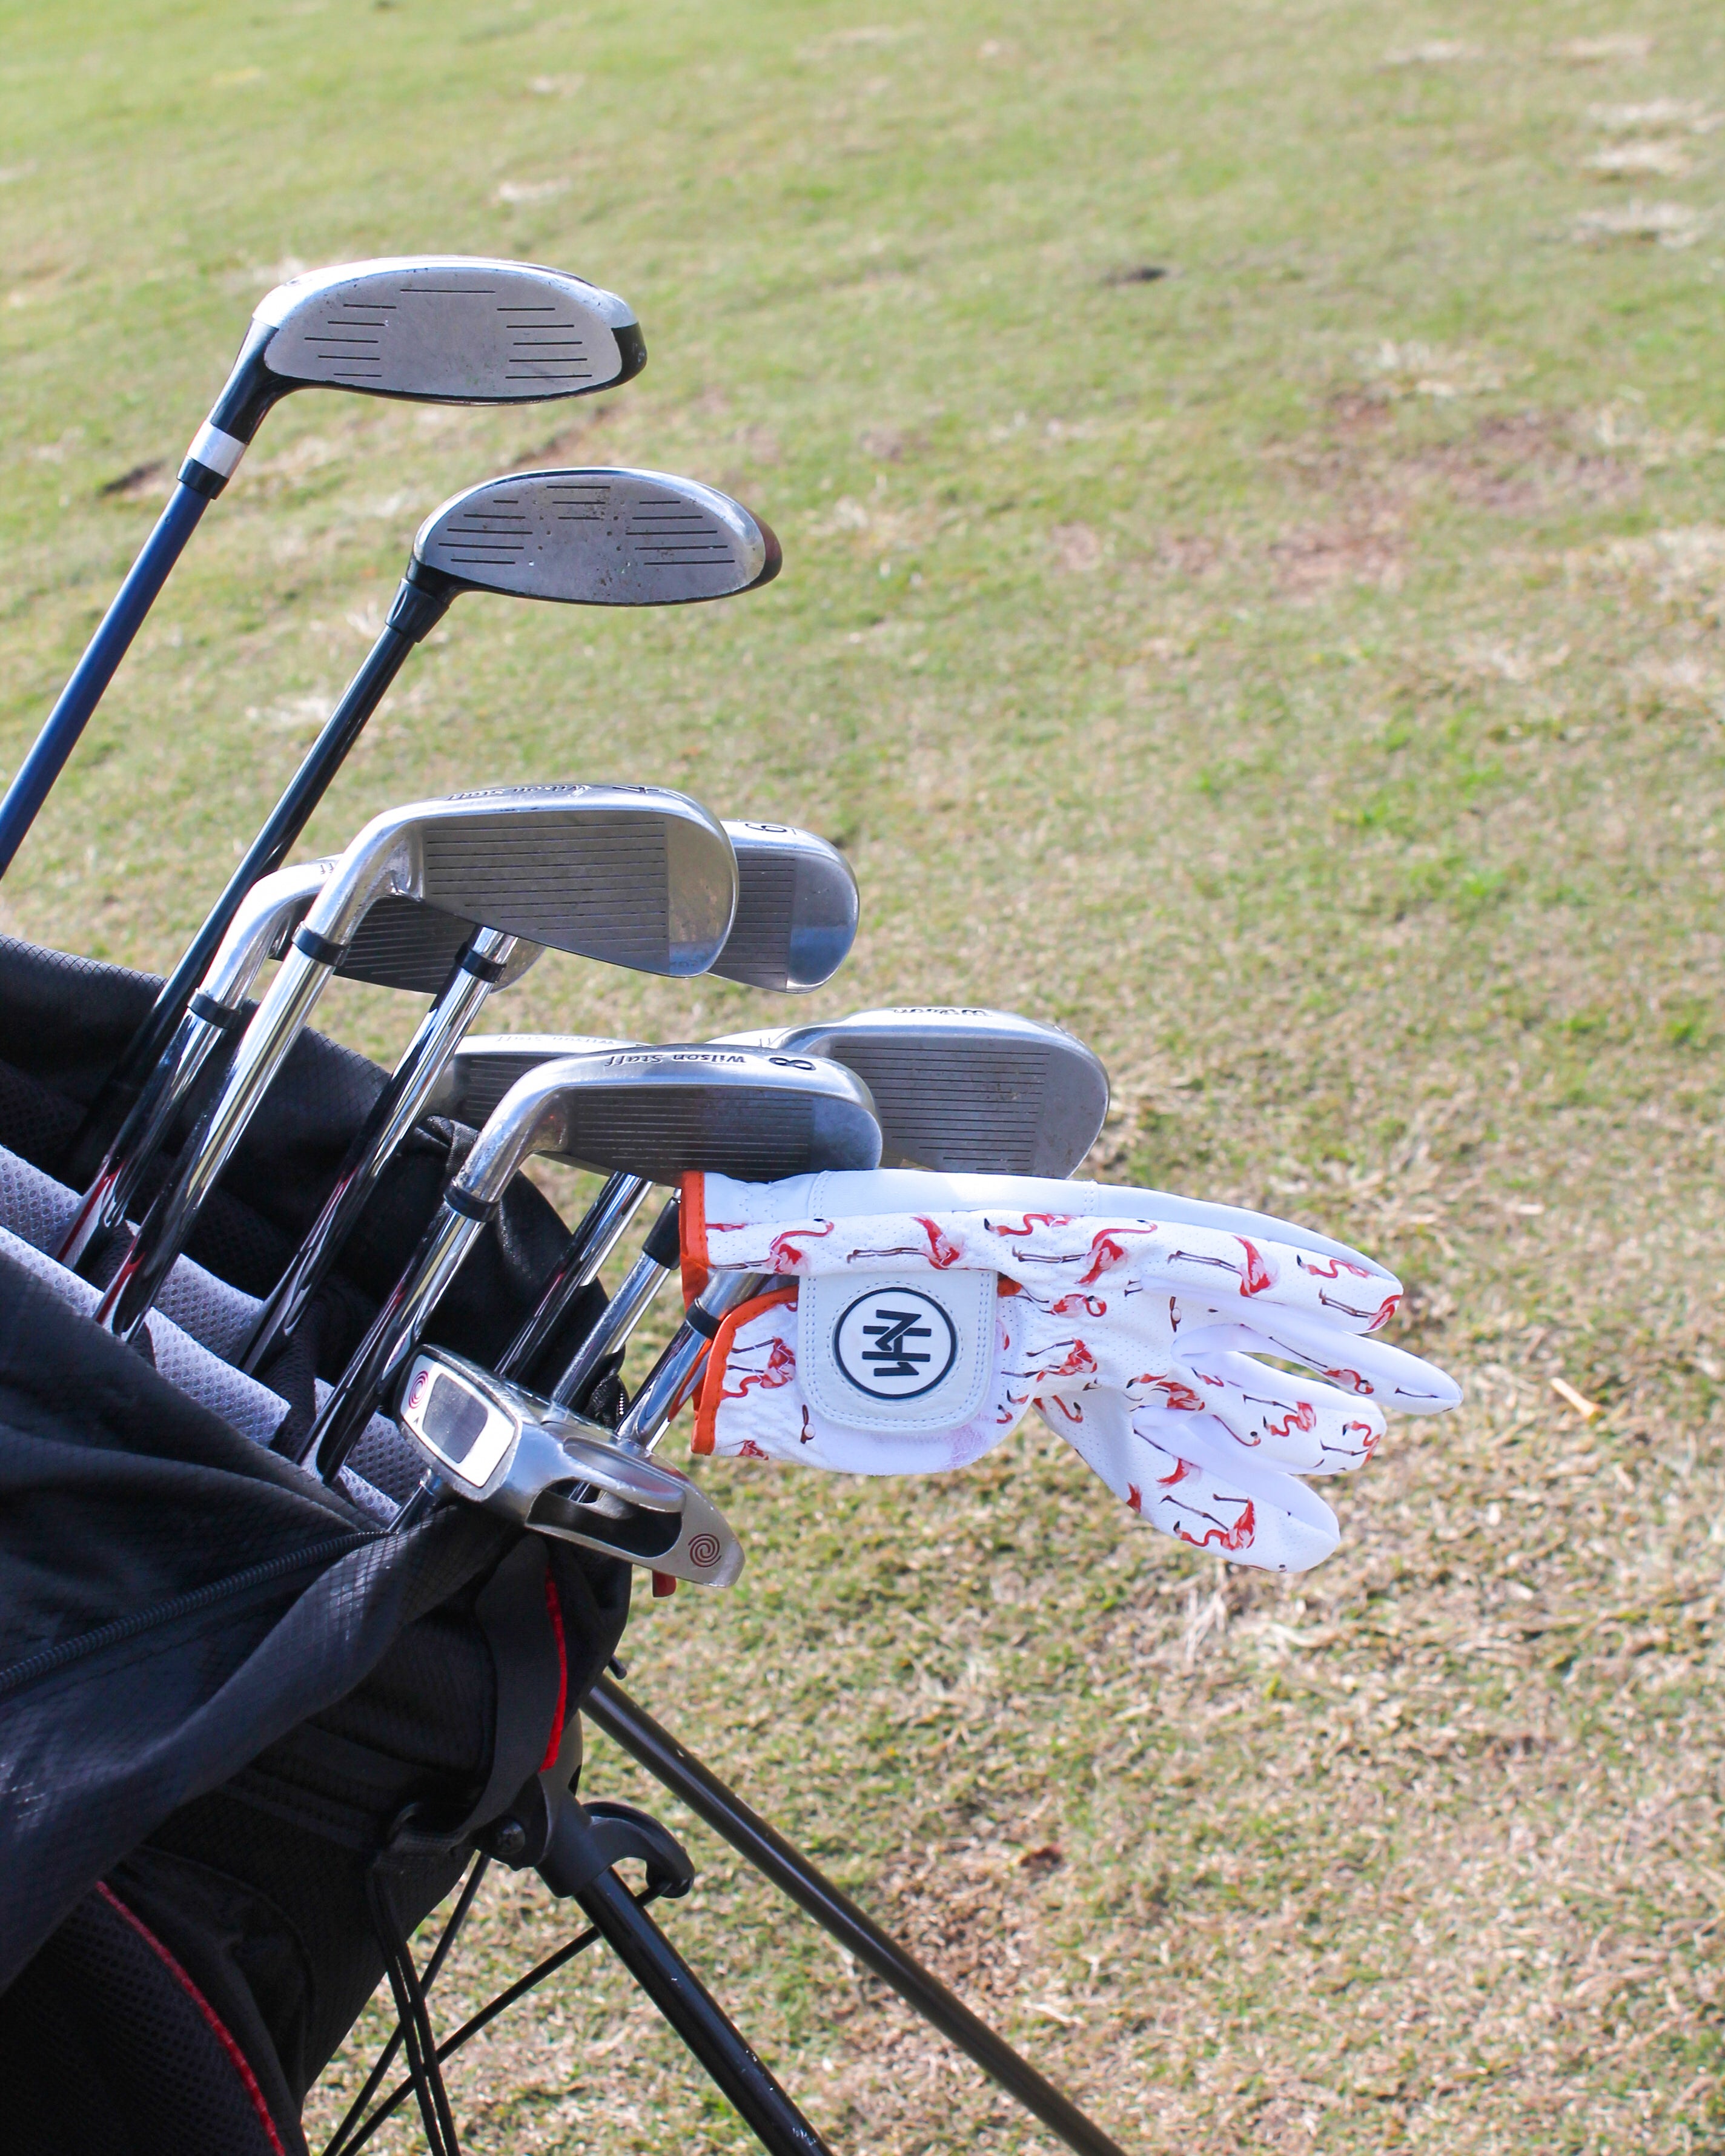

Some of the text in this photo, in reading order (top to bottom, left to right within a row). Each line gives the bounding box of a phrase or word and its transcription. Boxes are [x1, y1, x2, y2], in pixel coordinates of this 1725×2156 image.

[604, 1053, 746, 1067] Wilson Staff
[768, 1056, 817, 1071] 8
